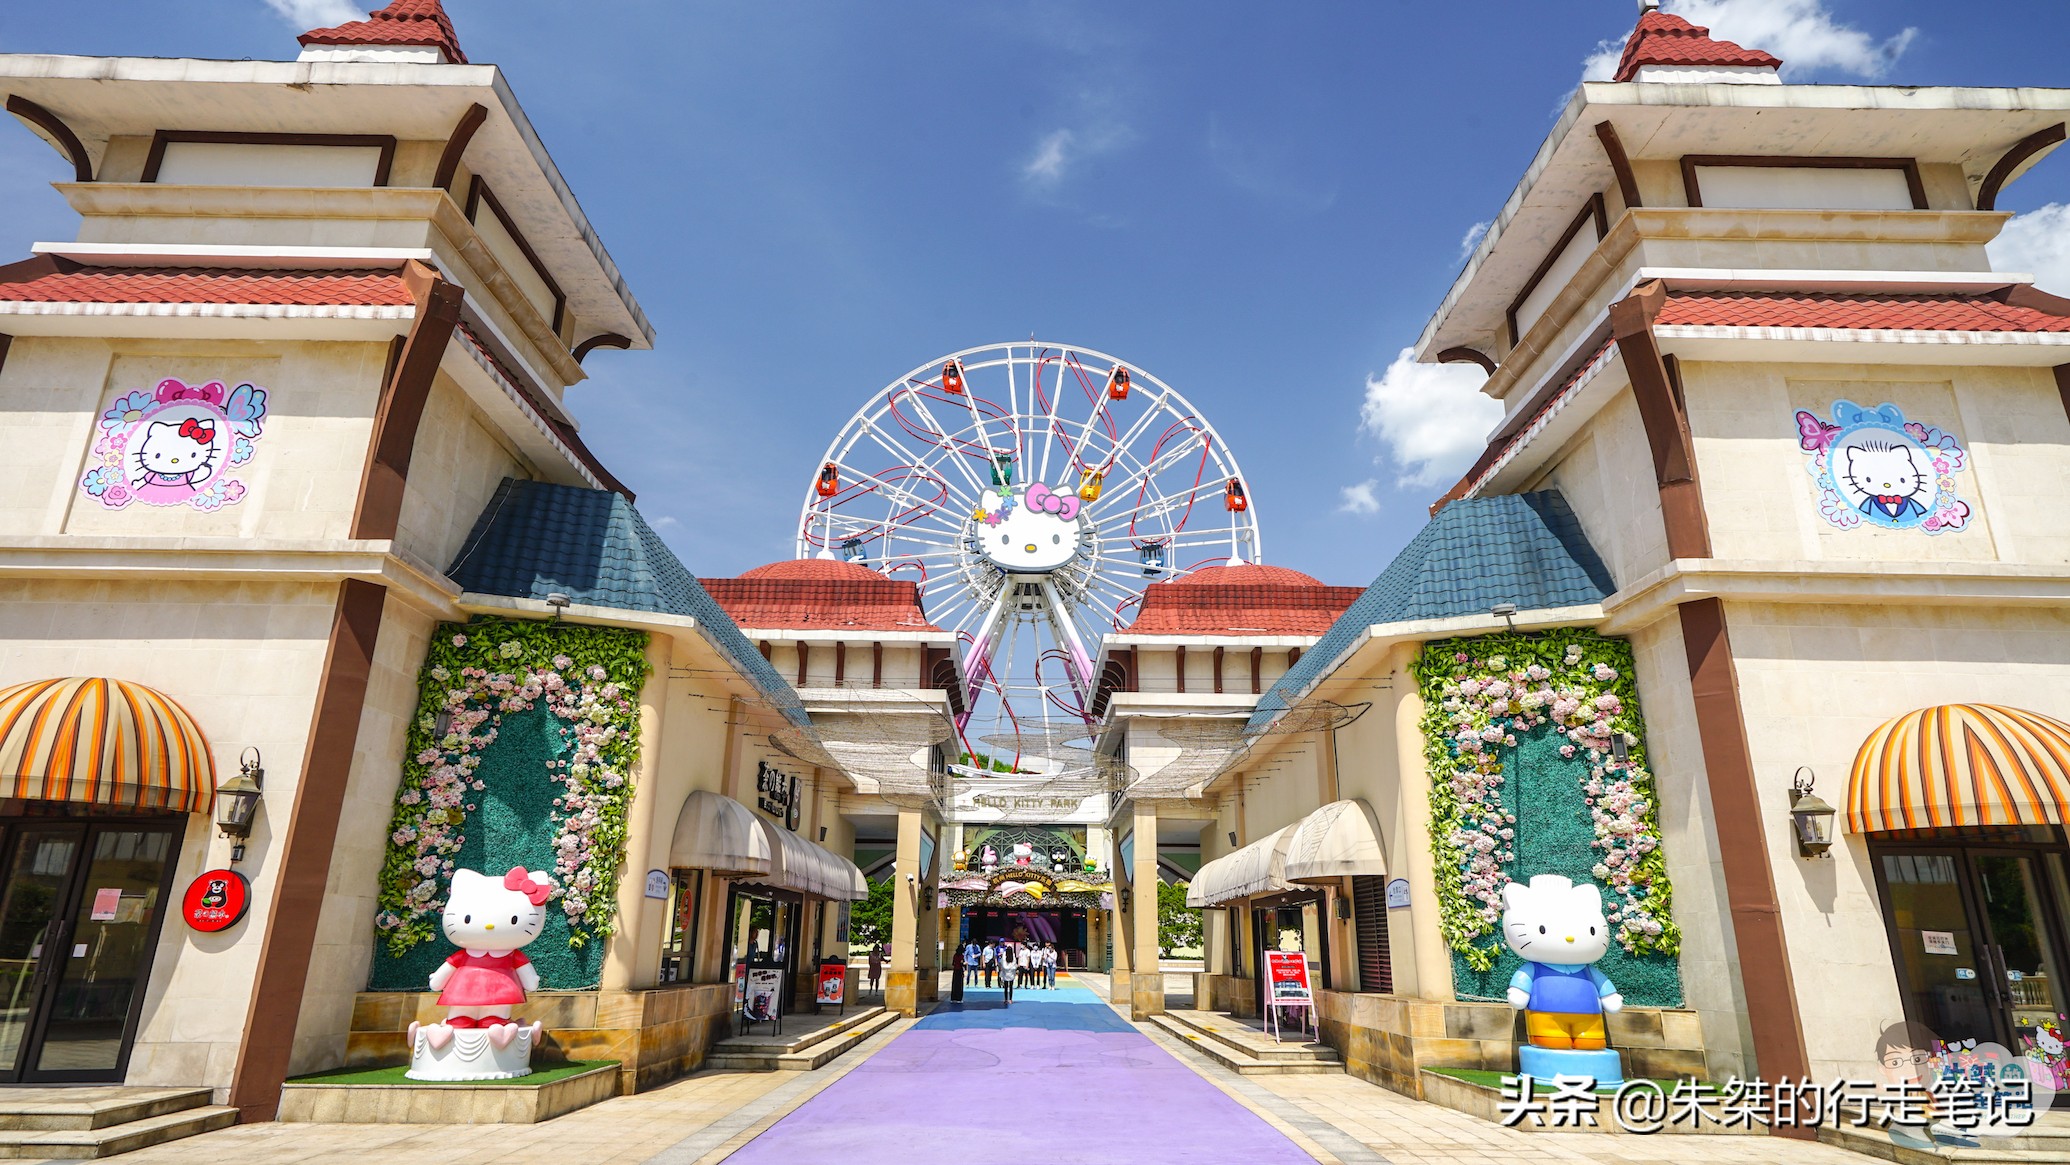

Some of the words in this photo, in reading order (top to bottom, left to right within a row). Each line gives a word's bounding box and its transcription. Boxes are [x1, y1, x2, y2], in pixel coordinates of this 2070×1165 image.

[973, 796, 1007, 808] HELLO
[1014, 798, 1044, 808] KITTY
[1050, 798, 1078, 808] PARK
